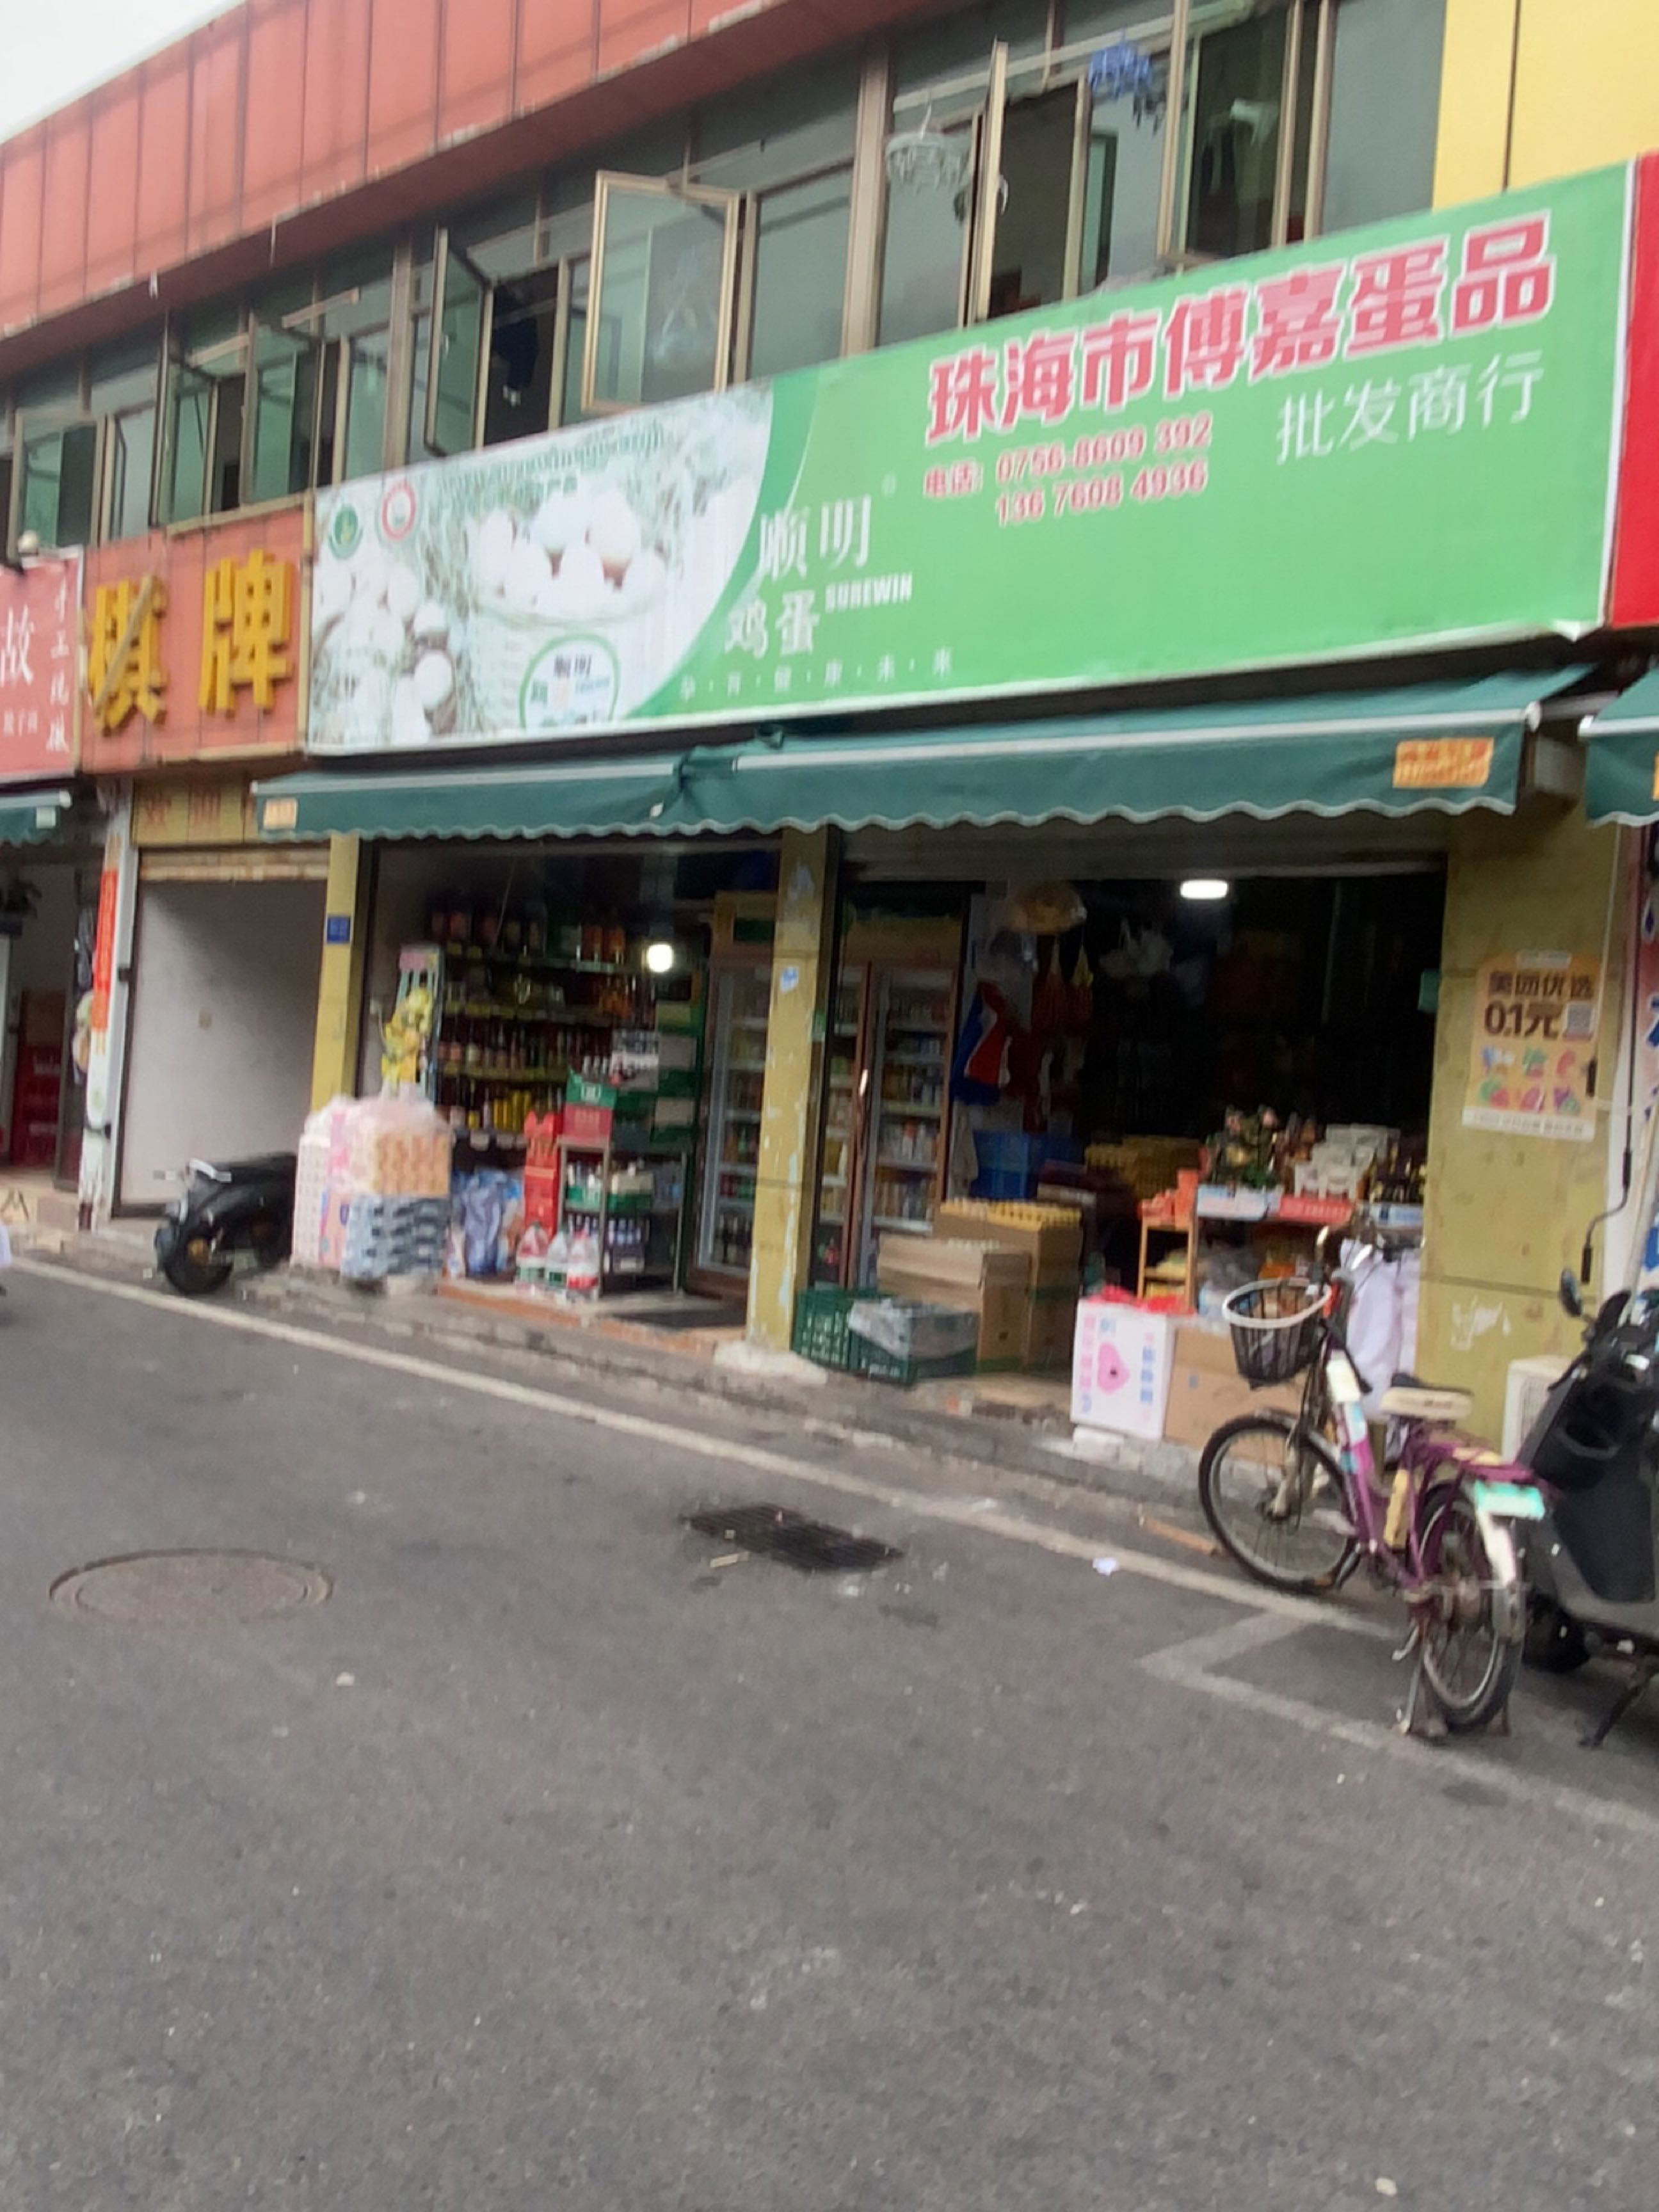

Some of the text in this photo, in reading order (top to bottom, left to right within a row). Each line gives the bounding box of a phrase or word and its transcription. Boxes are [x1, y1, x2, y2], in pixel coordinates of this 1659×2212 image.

[926, 212, 1555, 447] 珠海市傅嘉蛋品
[1154, 411, 1214, 453] 392
[1275, 351, 1544, 465] 批发商行
[725, 589, 820, 659] 鸡蛋
[1484, 1000, 1559, 1041] 0.1元
